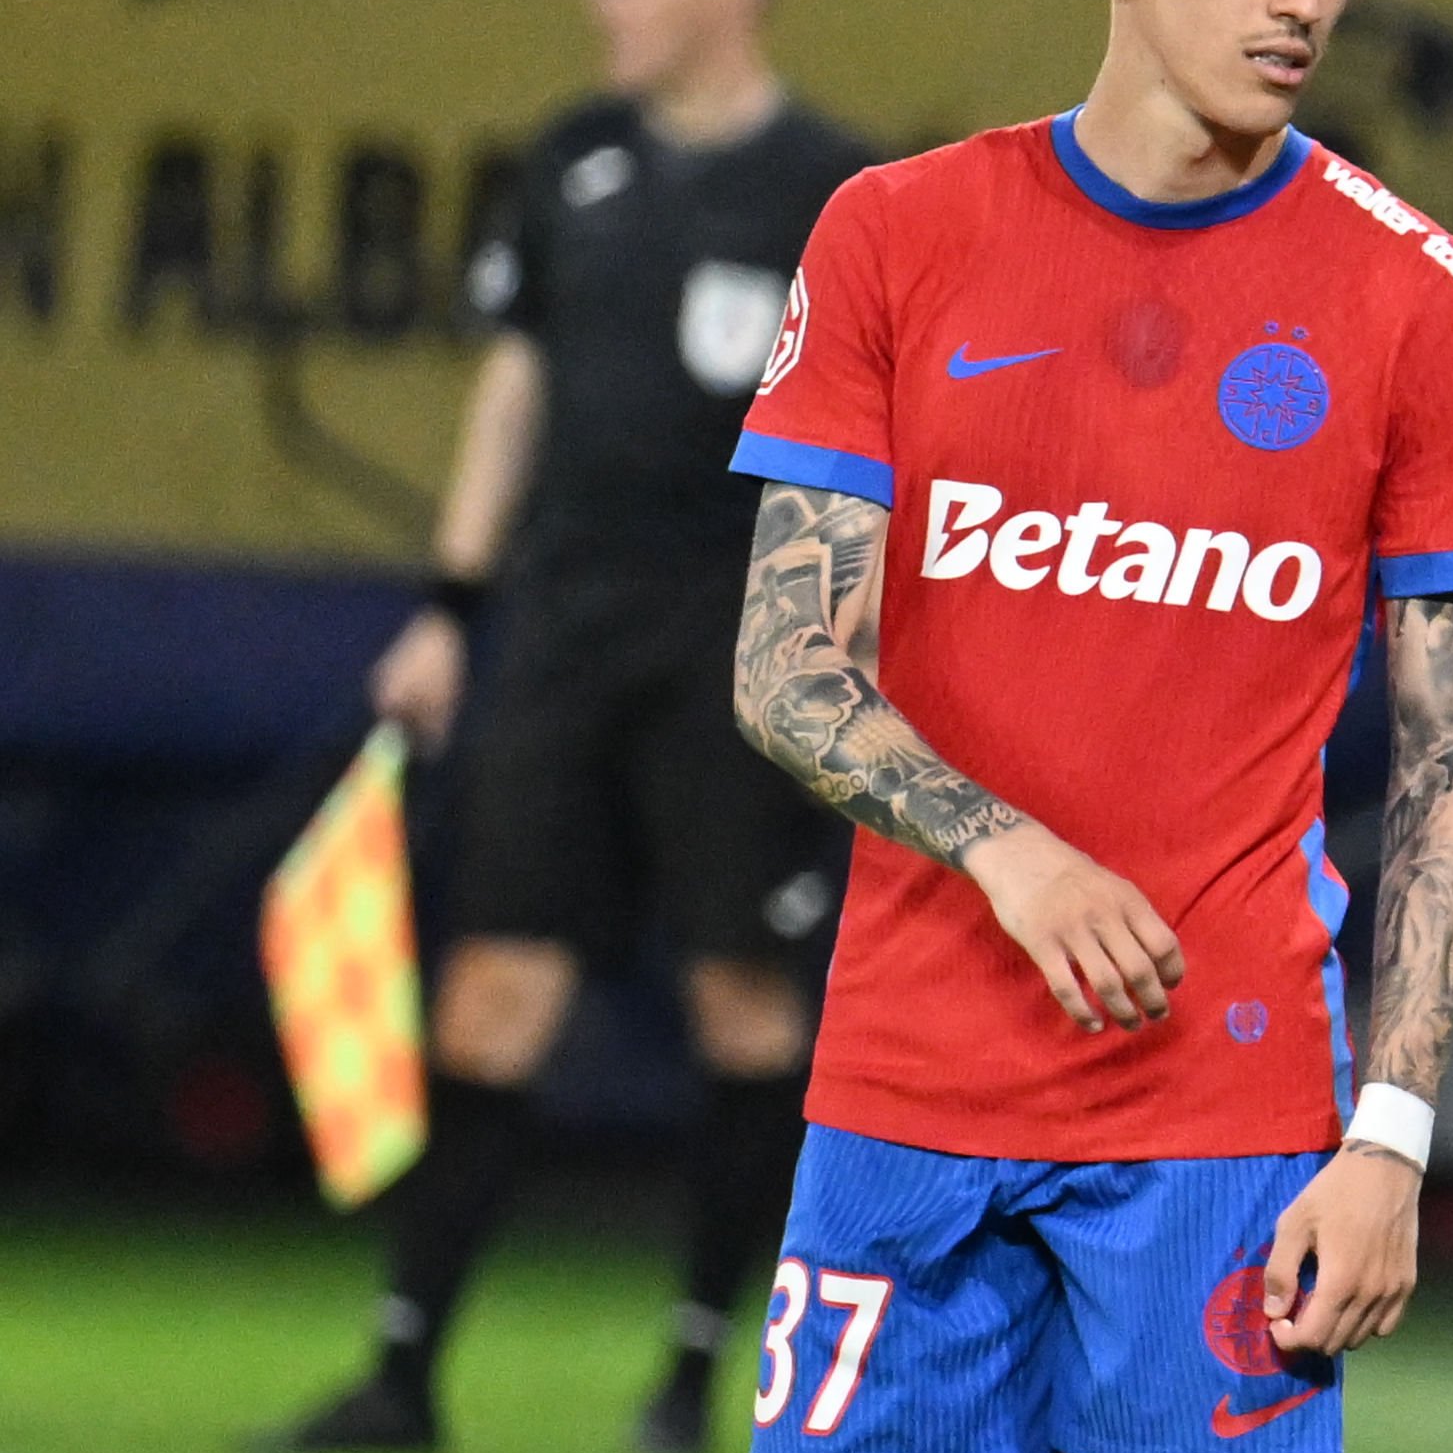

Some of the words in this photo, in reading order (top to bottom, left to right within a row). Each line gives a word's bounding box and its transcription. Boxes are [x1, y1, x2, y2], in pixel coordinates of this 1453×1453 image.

[1322, 159, 1430, 236] walter
[919, 478, 1323, 623] Betano
[754, 1256, 895, 1437] 37
